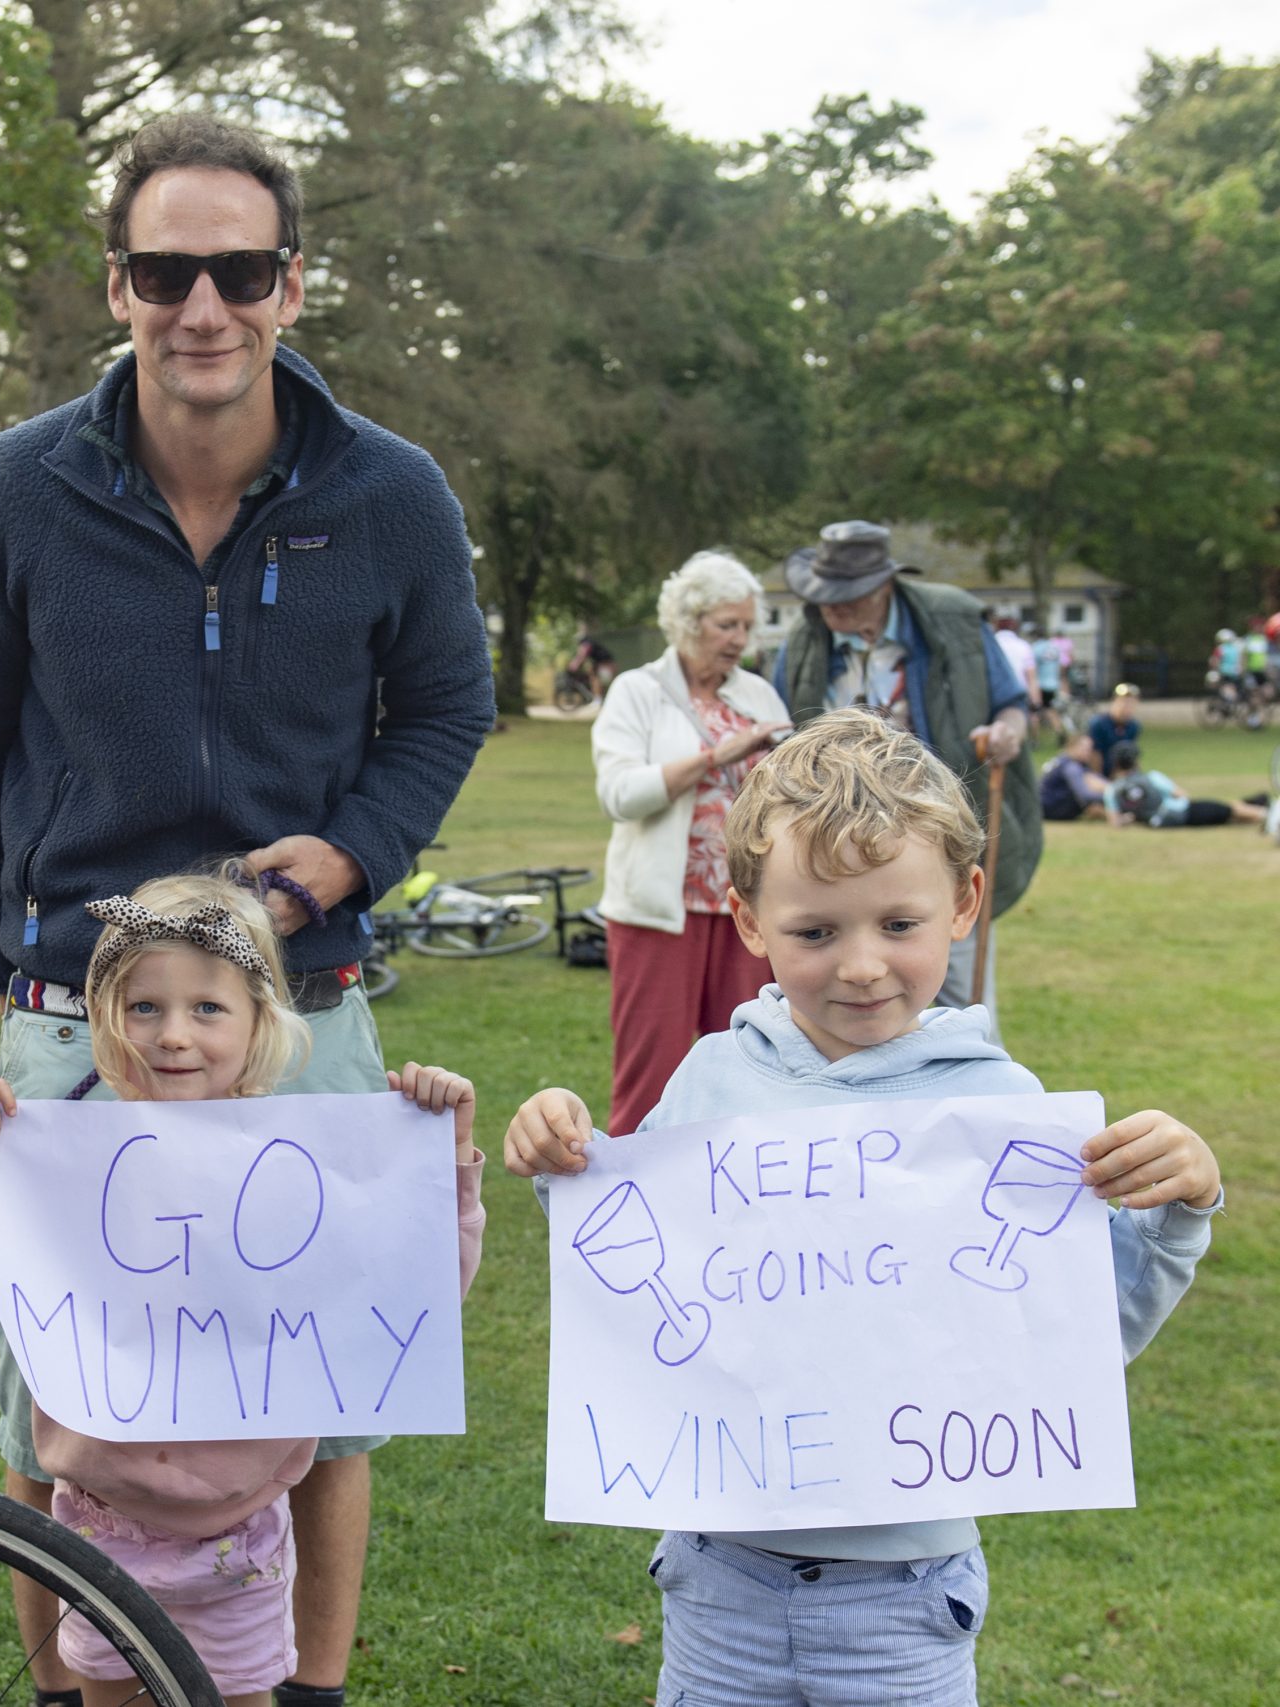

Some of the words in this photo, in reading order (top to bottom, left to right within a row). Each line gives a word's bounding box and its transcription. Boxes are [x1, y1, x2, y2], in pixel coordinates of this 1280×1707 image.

[102, 1134, 324, 1276] GO
[706, 1129, 901, 1214] KEEP
[702, 1243, 909, 1304] GOING
[11, 1282, 429, 1425] MUMMY
[586, 1404, 840, 1500] WINE
[889, 1403, 1082, 1489] SOON
